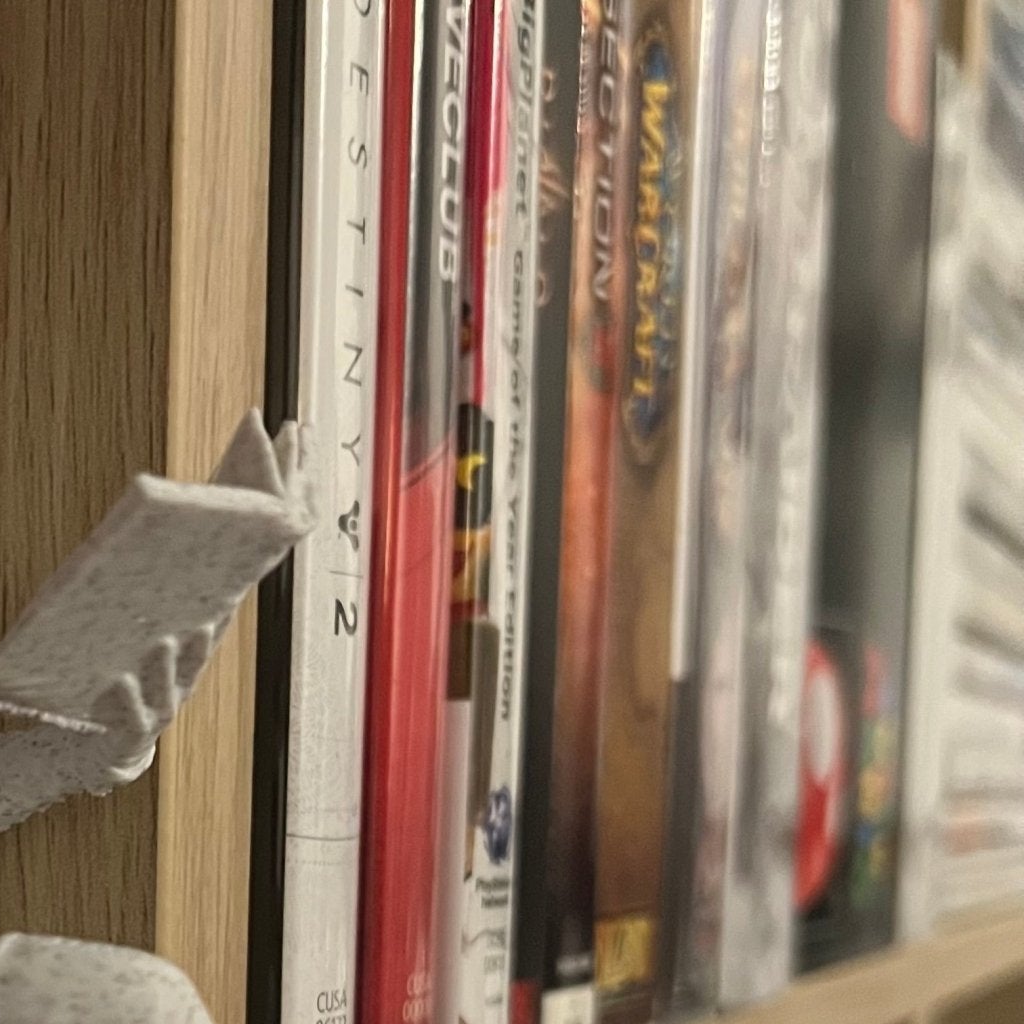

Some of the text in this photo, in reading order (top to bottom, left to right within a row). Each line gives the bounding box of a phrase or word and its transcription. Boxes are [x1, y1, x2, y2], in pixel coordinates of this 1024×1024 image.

[632, 82, 669, 397] WARCRAFT
[333, 598, 357, 636] 2
[501, 592, 517, 722] Edition
[316, 989, 347, 1013] CUSA
